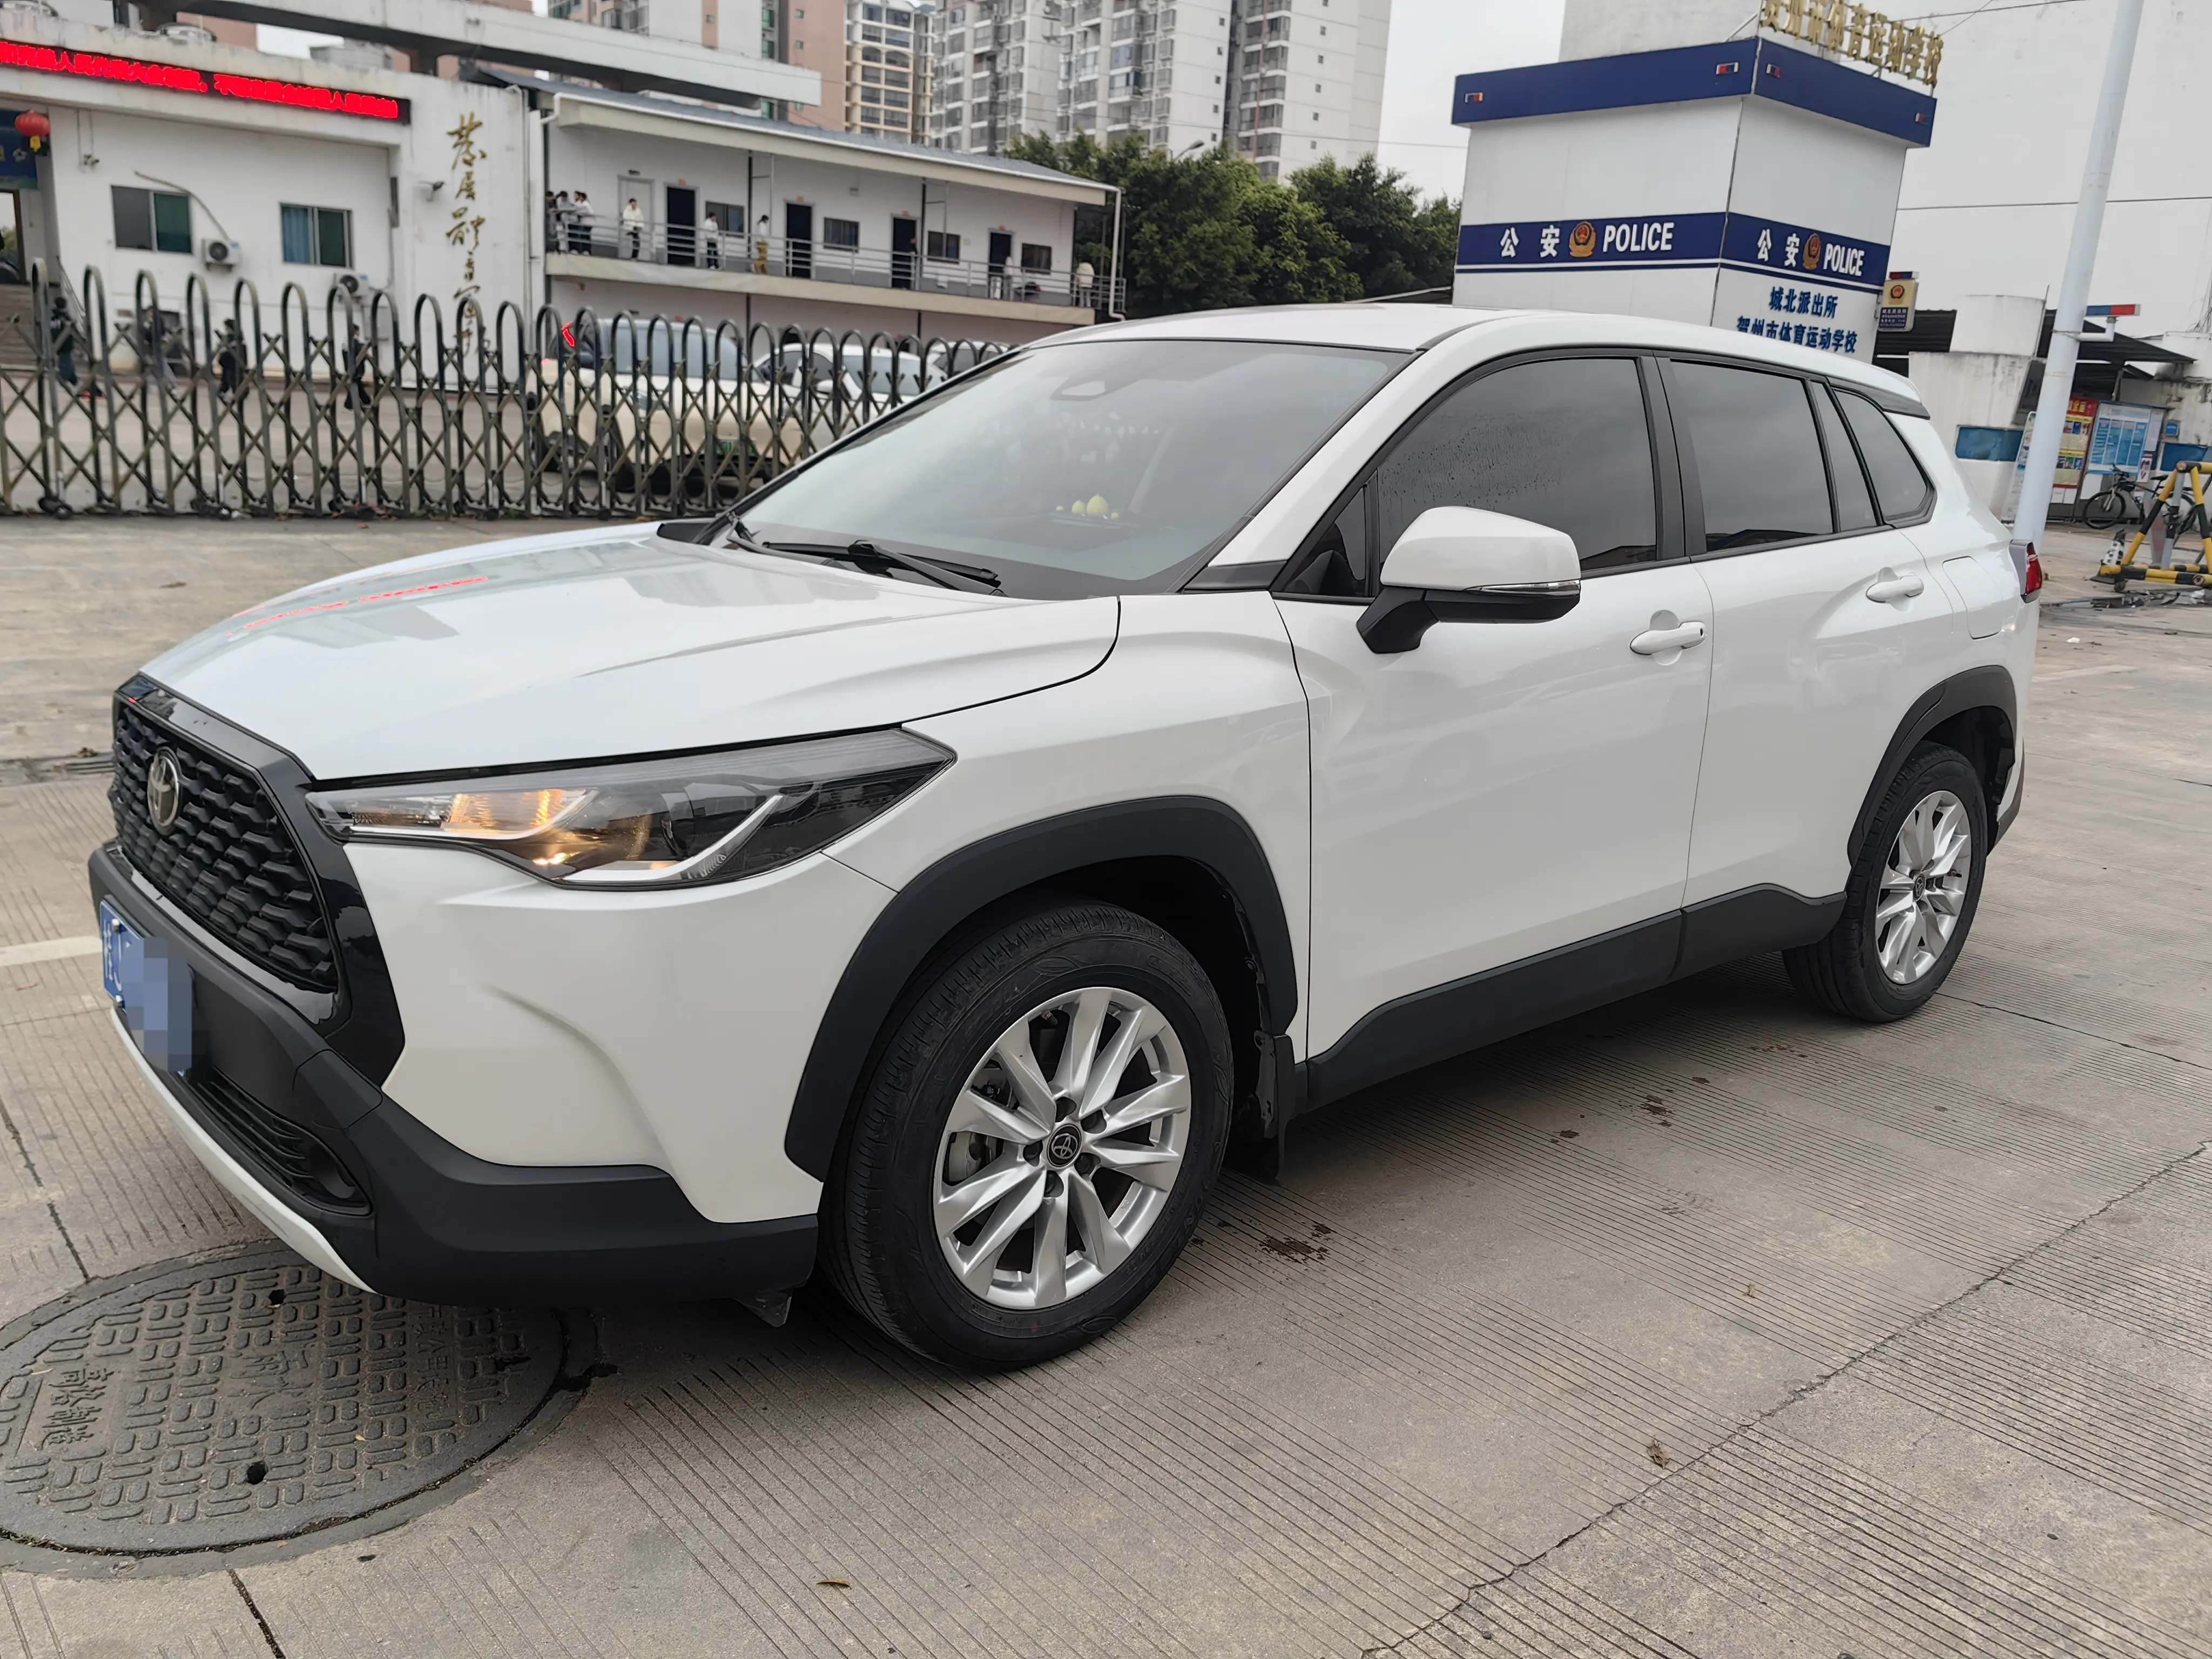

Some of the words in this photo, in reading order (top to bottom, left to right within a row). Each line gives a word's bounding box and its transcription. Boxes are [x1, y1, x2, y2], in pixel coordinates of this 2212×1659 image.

[1602, 222, 1675, 253] POLICE
[1823, 243, 1865, 276] POLICE
[1769, 286, 1838, 319] 城北派出所
[1736, 315, 1858, 353] 贺州市体育运动学校
